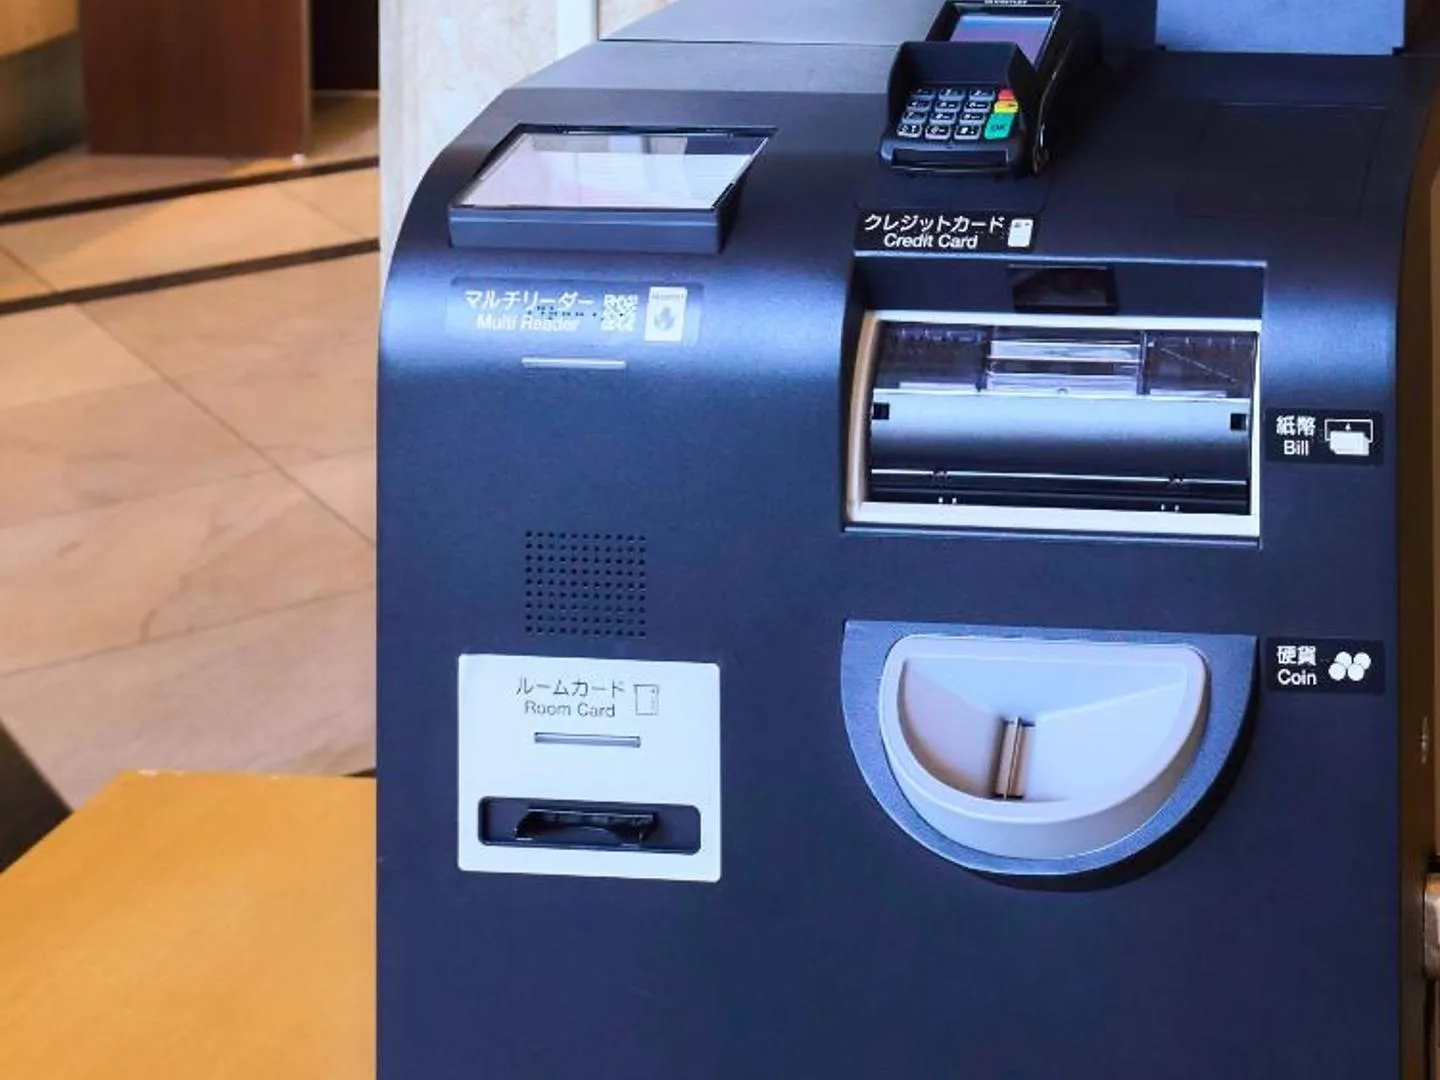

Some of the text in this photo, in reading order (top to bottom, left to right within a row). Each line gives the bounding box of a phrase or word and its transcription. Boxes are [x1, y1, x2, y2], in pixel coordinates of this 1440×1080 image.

[864, 214, 1005, 234] クレジットカード
[883, 232, 978, 249] Credit Card
[464, 289, 595, 311] マルチリーダー
[475, 313, 580, 332] Multi Reader
[1276, 415, 1317, 437] 紙幣
[1283, 439, 1310, 456] Bill
[1276, 645, 1317, 666] 硬貨
[515, 675, 627, 698] ルームカード
[1277, 669, 1317, 686] Coin
[523, 700, 616, 717] Room Card
